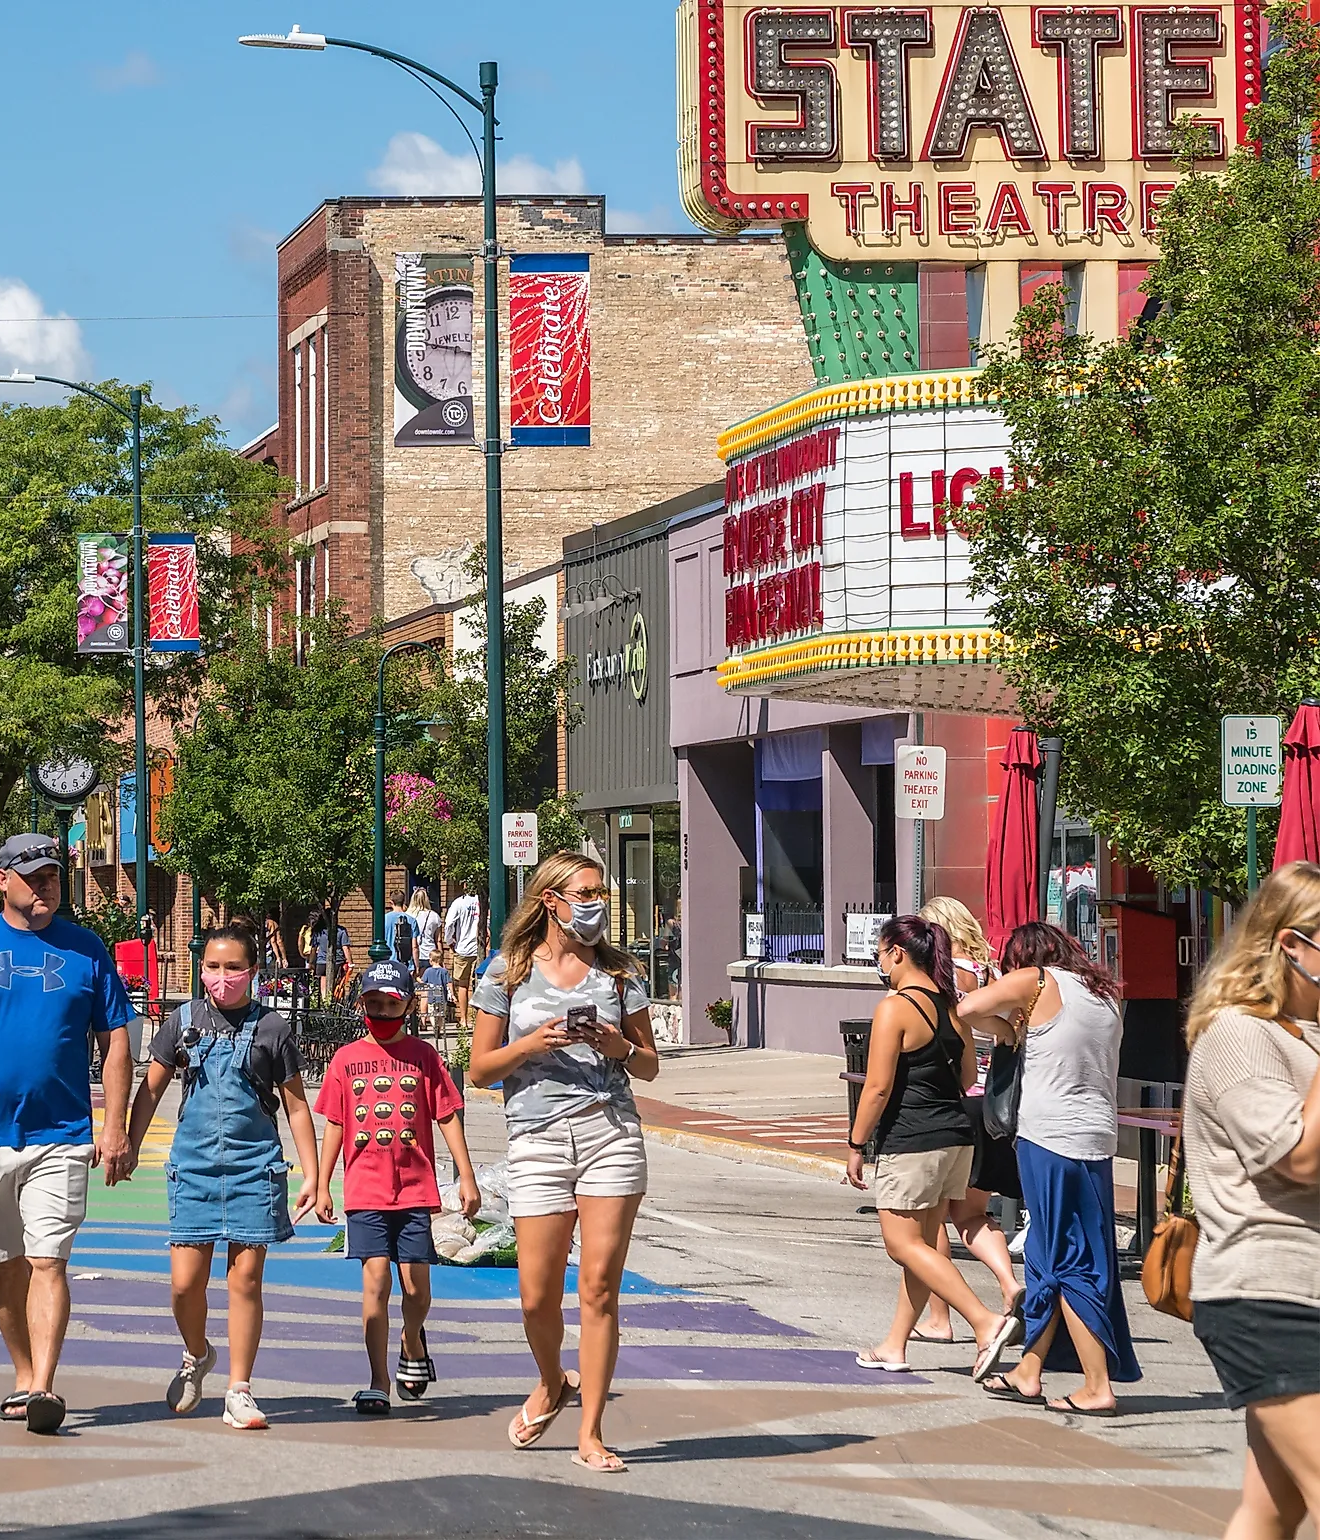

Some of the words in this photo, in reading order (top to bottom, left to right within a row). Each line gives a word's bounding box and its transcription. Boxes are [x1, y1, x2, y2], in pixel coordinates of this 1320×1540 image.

[745, 7, 1224, 160] STATE
[406, 266, 427, 351] DOWNTOWN
[445, 306, 460, 321] 12
[435, 332, 472, 346] JEWELE
[537, 277, 564, 424] Celebrate!
[84, 541, 98, 595] DOWNTOWN
[165, 547, 182, 639] Celebrate!
[1246, 728, 1257, 740] 15
[1231, 746, 1272, 757] MINUTE
[916, 756, 928, 766] NO
[904, 770, 938, 780] PARKING
[1227, 764, 1277, 775] LOADING
[903, 784, 938, 795] THEATER
[1237, 781, 1267, 793] ZONE
[911, 799, 929, 808] EXIT
[515, 820, 524, 828] NO
[507, 830, 533, 838] PARKING
[507, 840, 533, 848] THEATER
[513, 850, 527, 858] EXIT
[344, 1060, 378, 1079] MOODS
[380, 1059, 388, 1067] OF
[391, 1059, 424, 1073] NINJA
